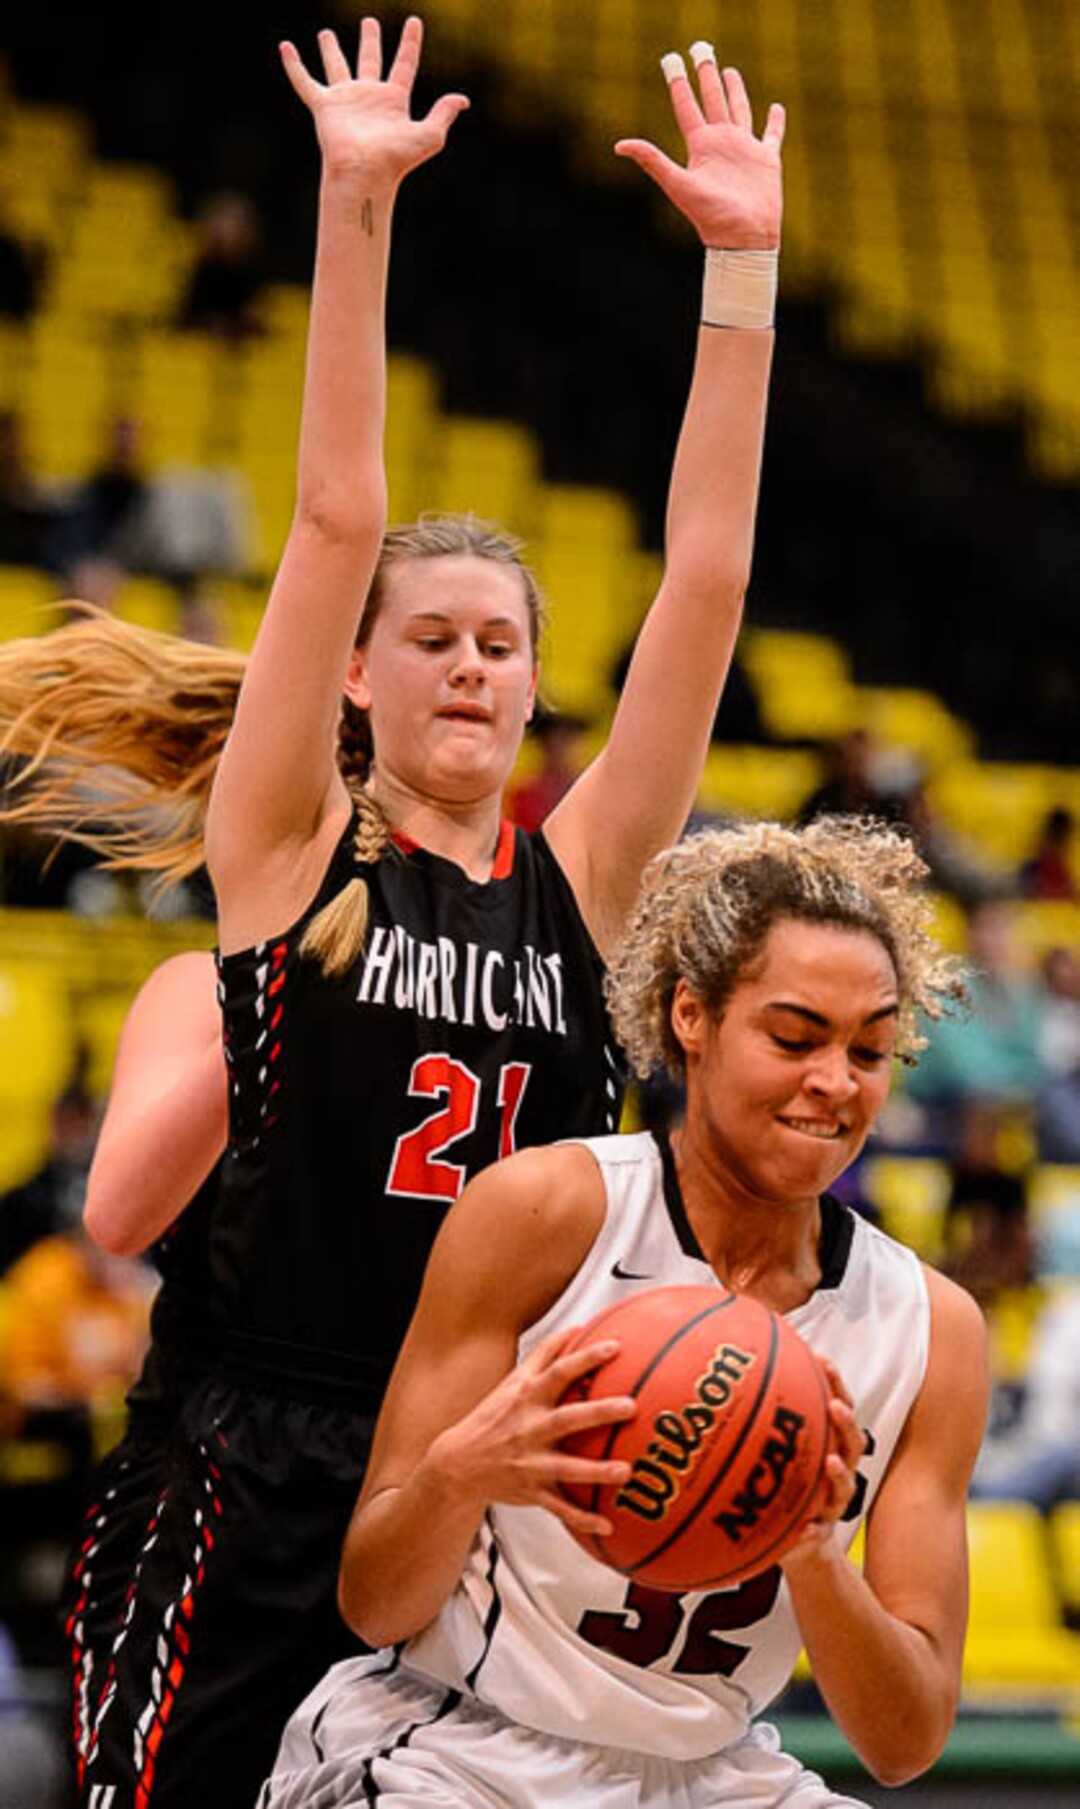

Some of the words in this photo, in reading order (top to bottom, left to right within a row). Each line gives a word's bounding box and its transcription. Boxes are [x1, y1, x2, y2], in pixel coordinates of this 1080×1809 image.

[385, 1052, 532, 1202] 21
[614, 1342, 756, 1522] Wilson
[712, 1405, 805, 1543] NCAA
[576, 1562, 783, 1678] 32
